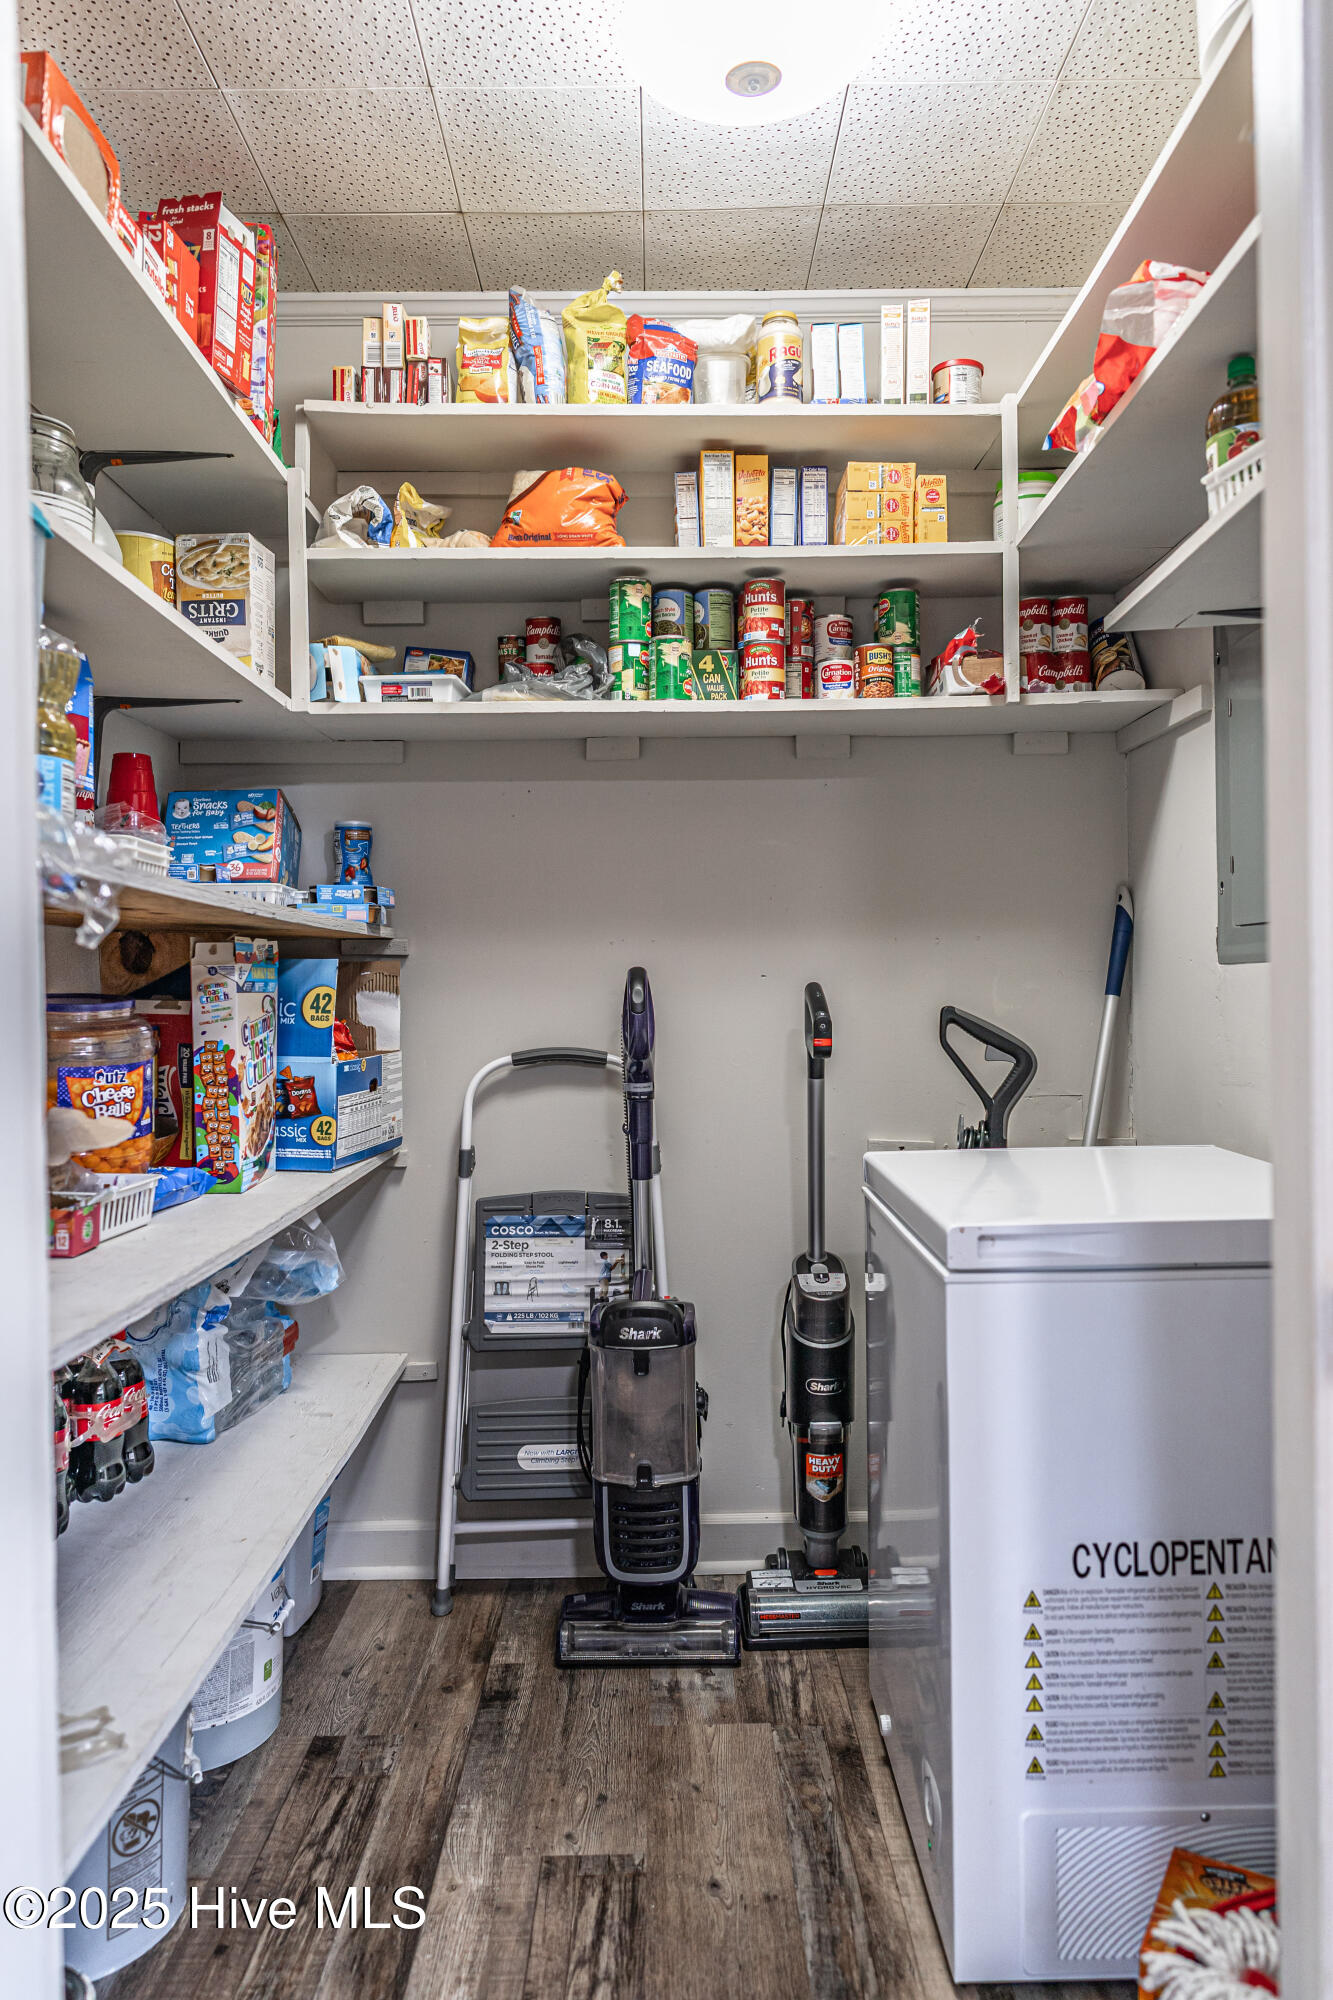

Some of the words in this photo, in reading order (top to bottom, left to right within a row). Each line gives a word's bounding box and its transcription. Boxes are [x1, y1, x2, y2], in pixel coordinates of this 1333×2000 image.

[161, 206, 185, 216] fresh
[186, 201, 215, 212] stacks
[646, 361, 692, 380] SEAFOOD
[524, 533, 552, 542] Original
[188, 602, 239, 619] GRITS
[868, 652, 892, 661] BUSH'S
[698, 655, 715, 673] 4
[822, 668, 852, 679] Carnation
[1038, 664, 1084, 681] Campbell's
[702, 673, 721, 684] CAN
[706, 684, 725, 692] VALUE
[710, 692, 728, 700] PACK
[192, 801, 229, 810] Snacks
[205, 809, 225, 817] Baby
[229, 863, 241, 872] 36
[309, 992, 333, 1015] 42
[280, 1017, 296, 1025] MIX
[183, 1047, 191, 1058] 20
[81, 1085, 136, 1108] Cheese
[291, 1088, 312, 1097] Doritos
[93, 1101, 132, 1119] Balls
[315, 1120, 333, 1136] 42
[491, 1225, 534, 1236] COSCO
[491, 1240, 529, 1251] 2-Step
[618, 1326, 663, 1341] Shark
[530, 1457, 560, 1465] Climbing
[808, 1455, 841, 1466] HEAVY
[812, 1464, 838, 1473] DUTY
[631, 1602, 666, 1611] Shark
